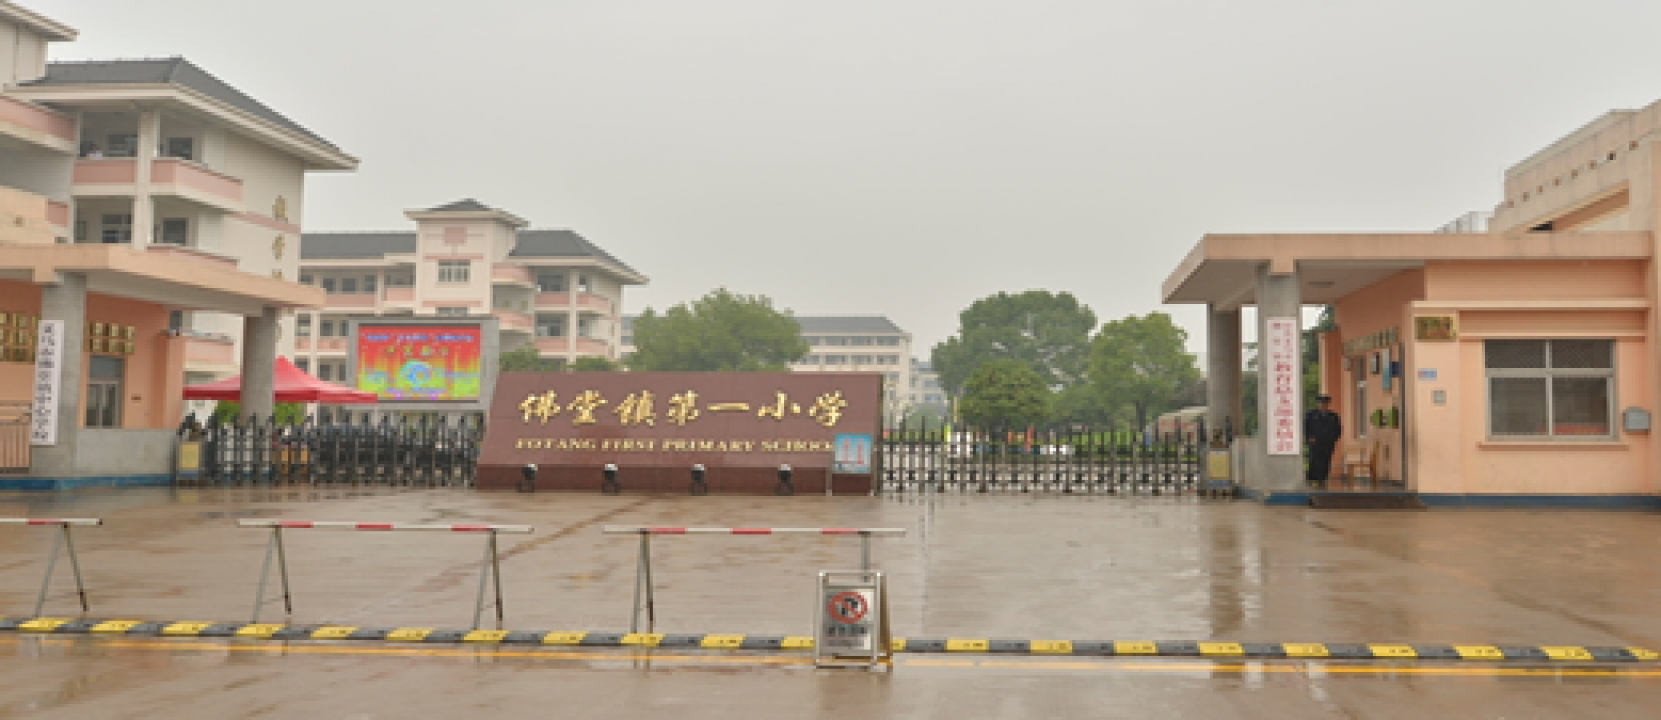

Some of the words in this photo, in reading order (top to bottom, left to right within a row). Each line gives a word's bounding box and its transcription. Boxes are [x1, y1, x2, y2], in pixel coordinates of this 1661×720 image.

[601, 437, 656, 451] FIRST
[662, 437, 755, 451] PRIMARY
[761, 438, 834, 452] SCHOO
